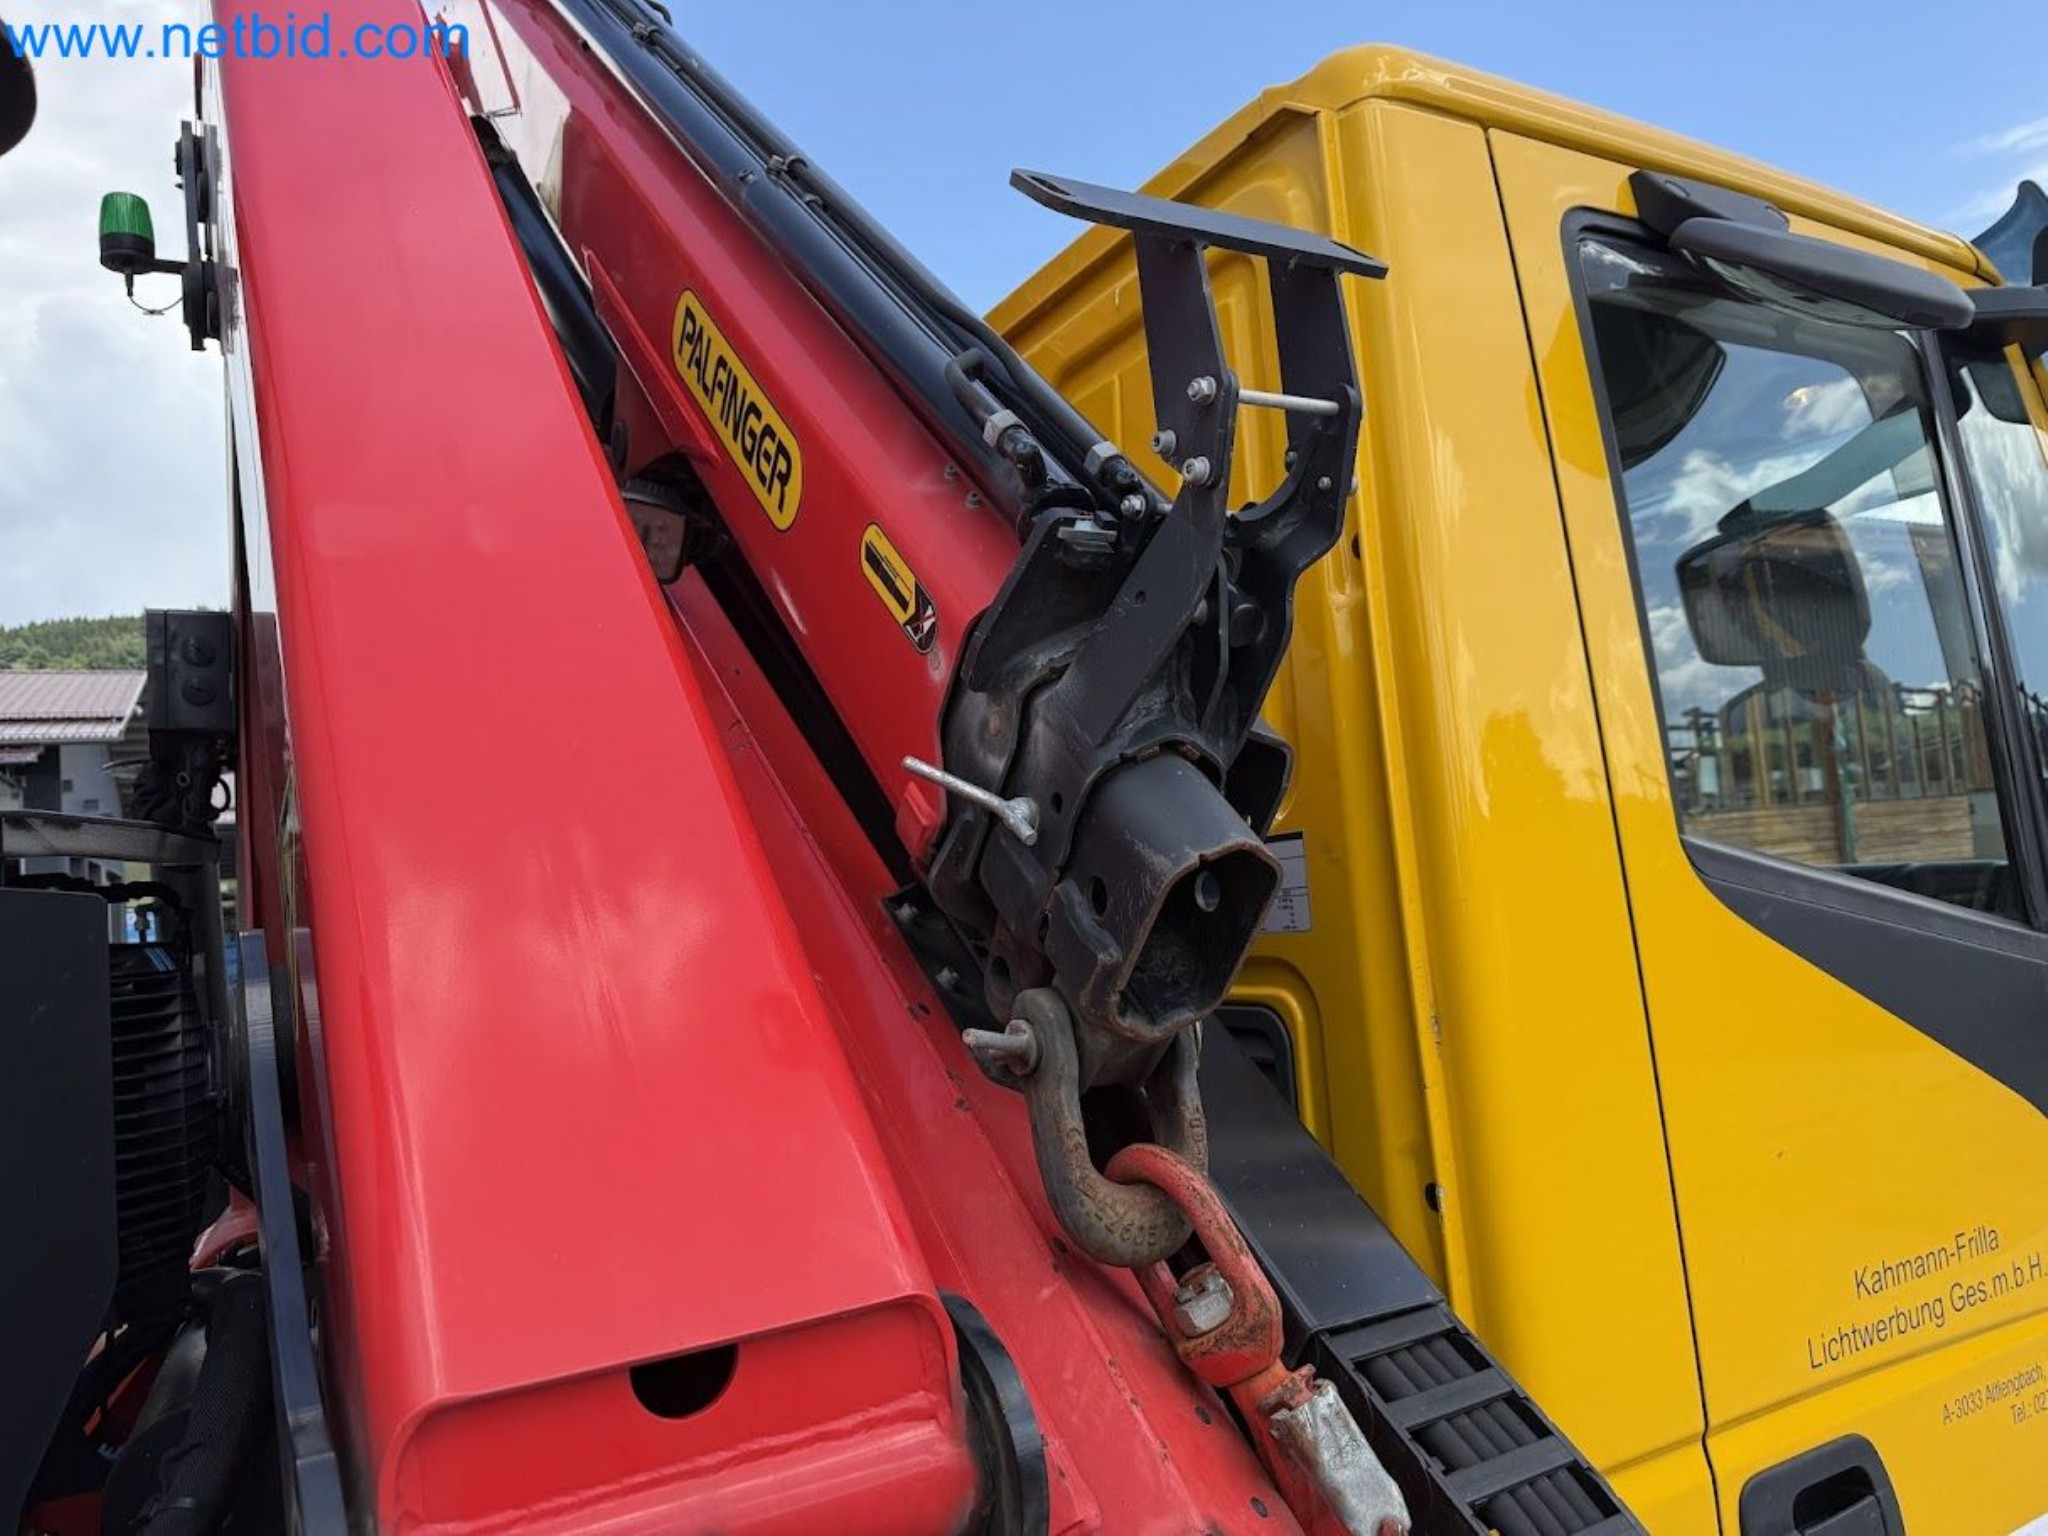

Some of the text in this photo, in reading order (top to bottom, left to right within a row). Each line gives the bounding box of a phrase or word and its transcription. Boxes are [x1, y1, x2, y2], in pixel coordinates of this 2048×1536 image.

[679, 305, 793, 513] PALFINGER
[1854, 1224, 2000, 1299] Kahmann-Frilla
[1807, 1252, 2048, 1369] Lichtwerbung Ges.m.b.H.
[1942, 1389, 1983, 1426] A-3033
